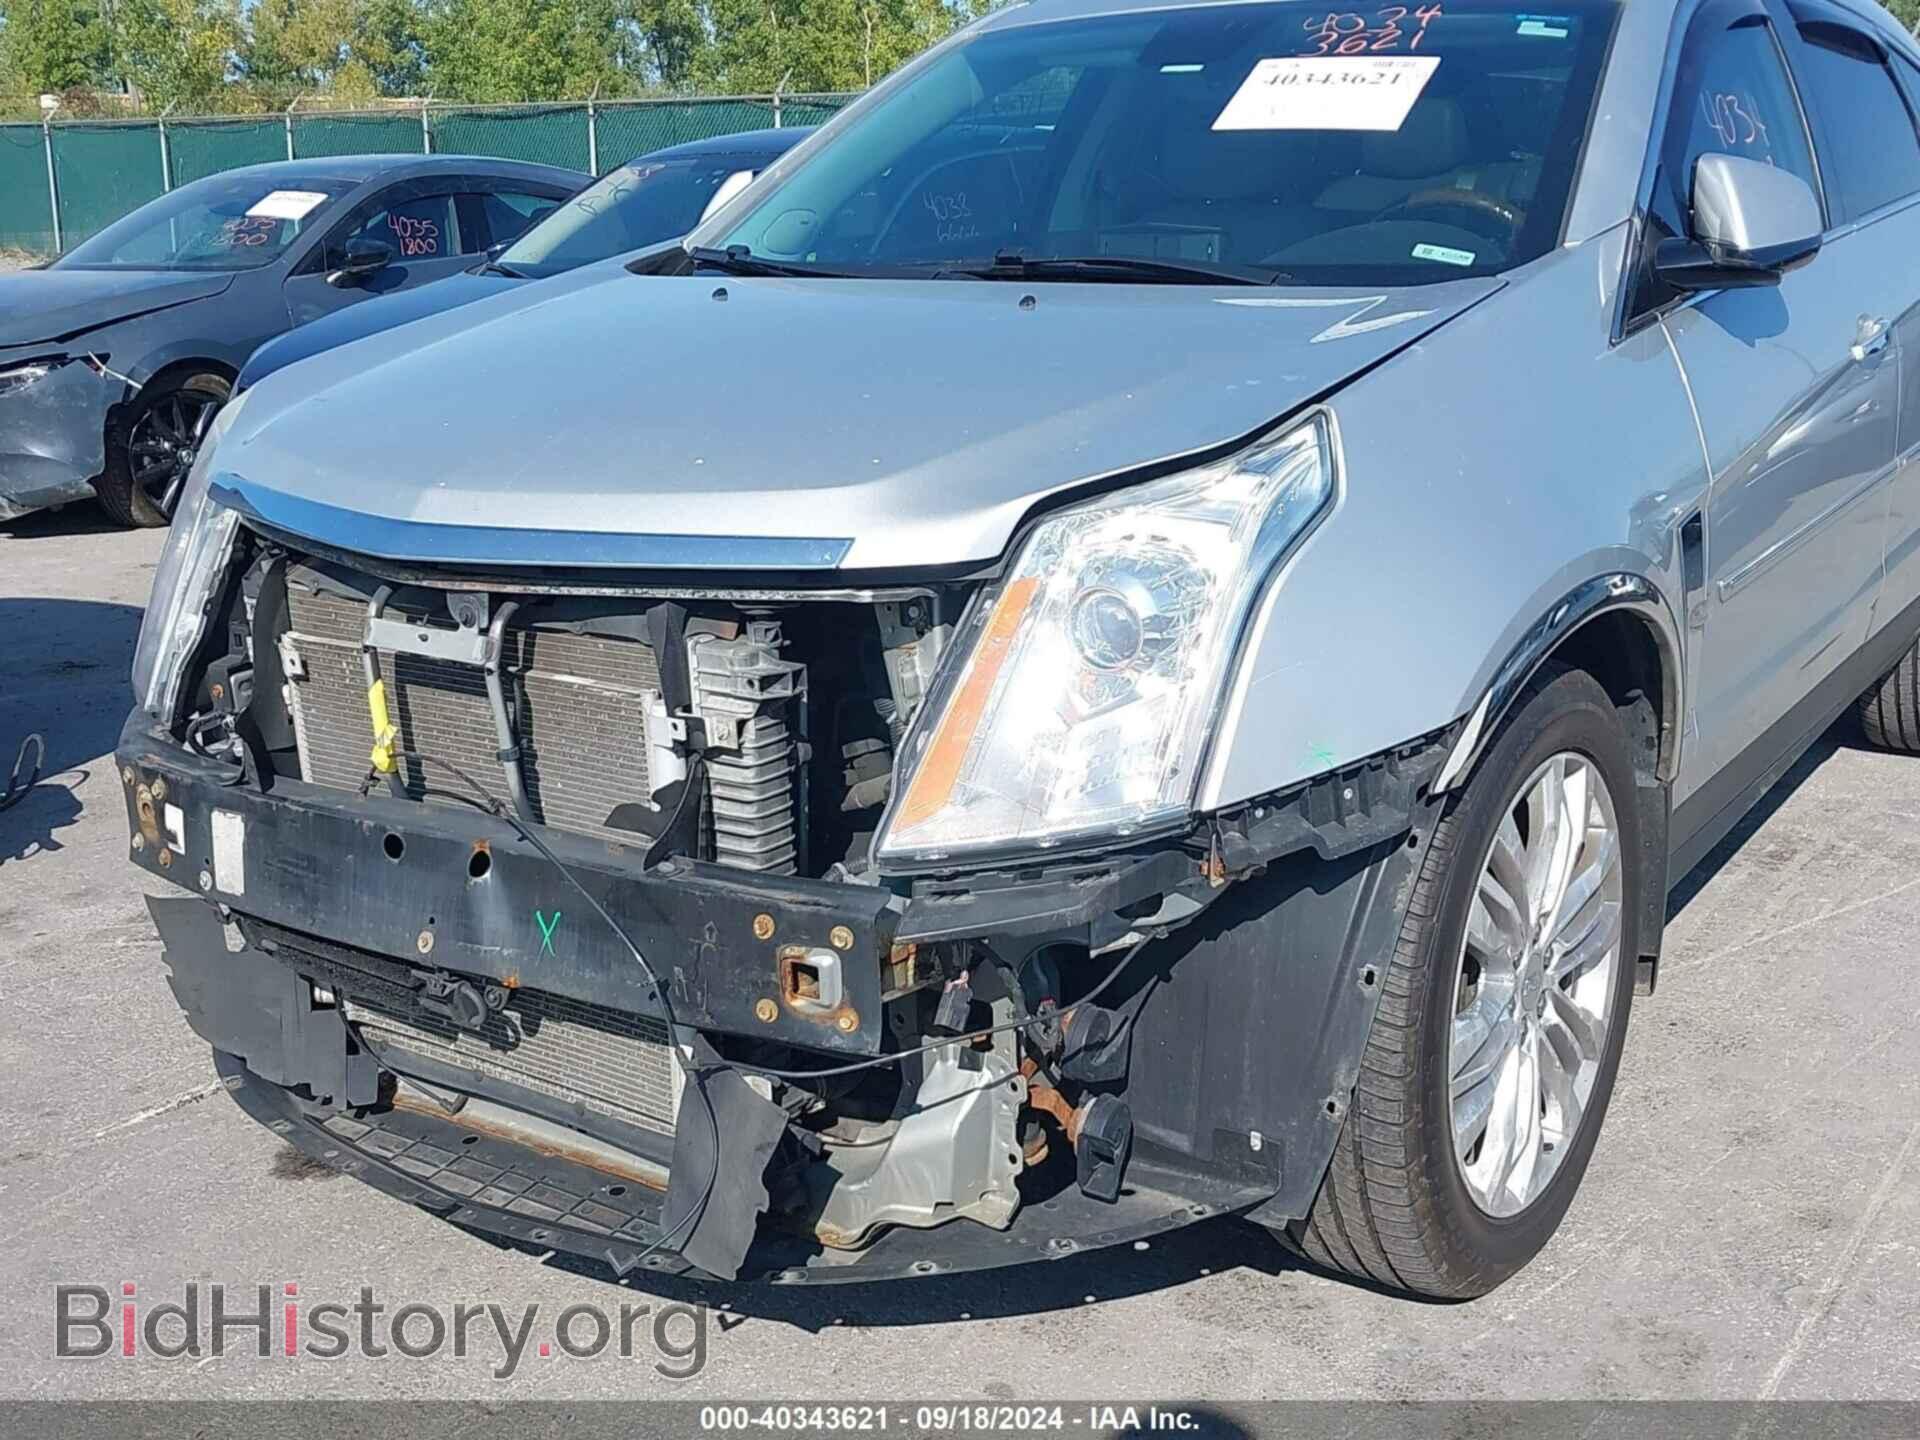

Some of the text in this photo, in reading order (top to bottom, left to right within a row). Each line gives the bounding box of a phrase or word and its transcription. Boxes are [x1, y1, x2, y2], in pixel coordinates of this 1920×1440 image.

[1303, 4, 1442, 35] 4034
[1297, 29, 1425, 56] 3621
[1264, 72, 1401, 86] 40343621
[388, 212, 439, 237] 4035
[400, 238, 437, 256] 1800
